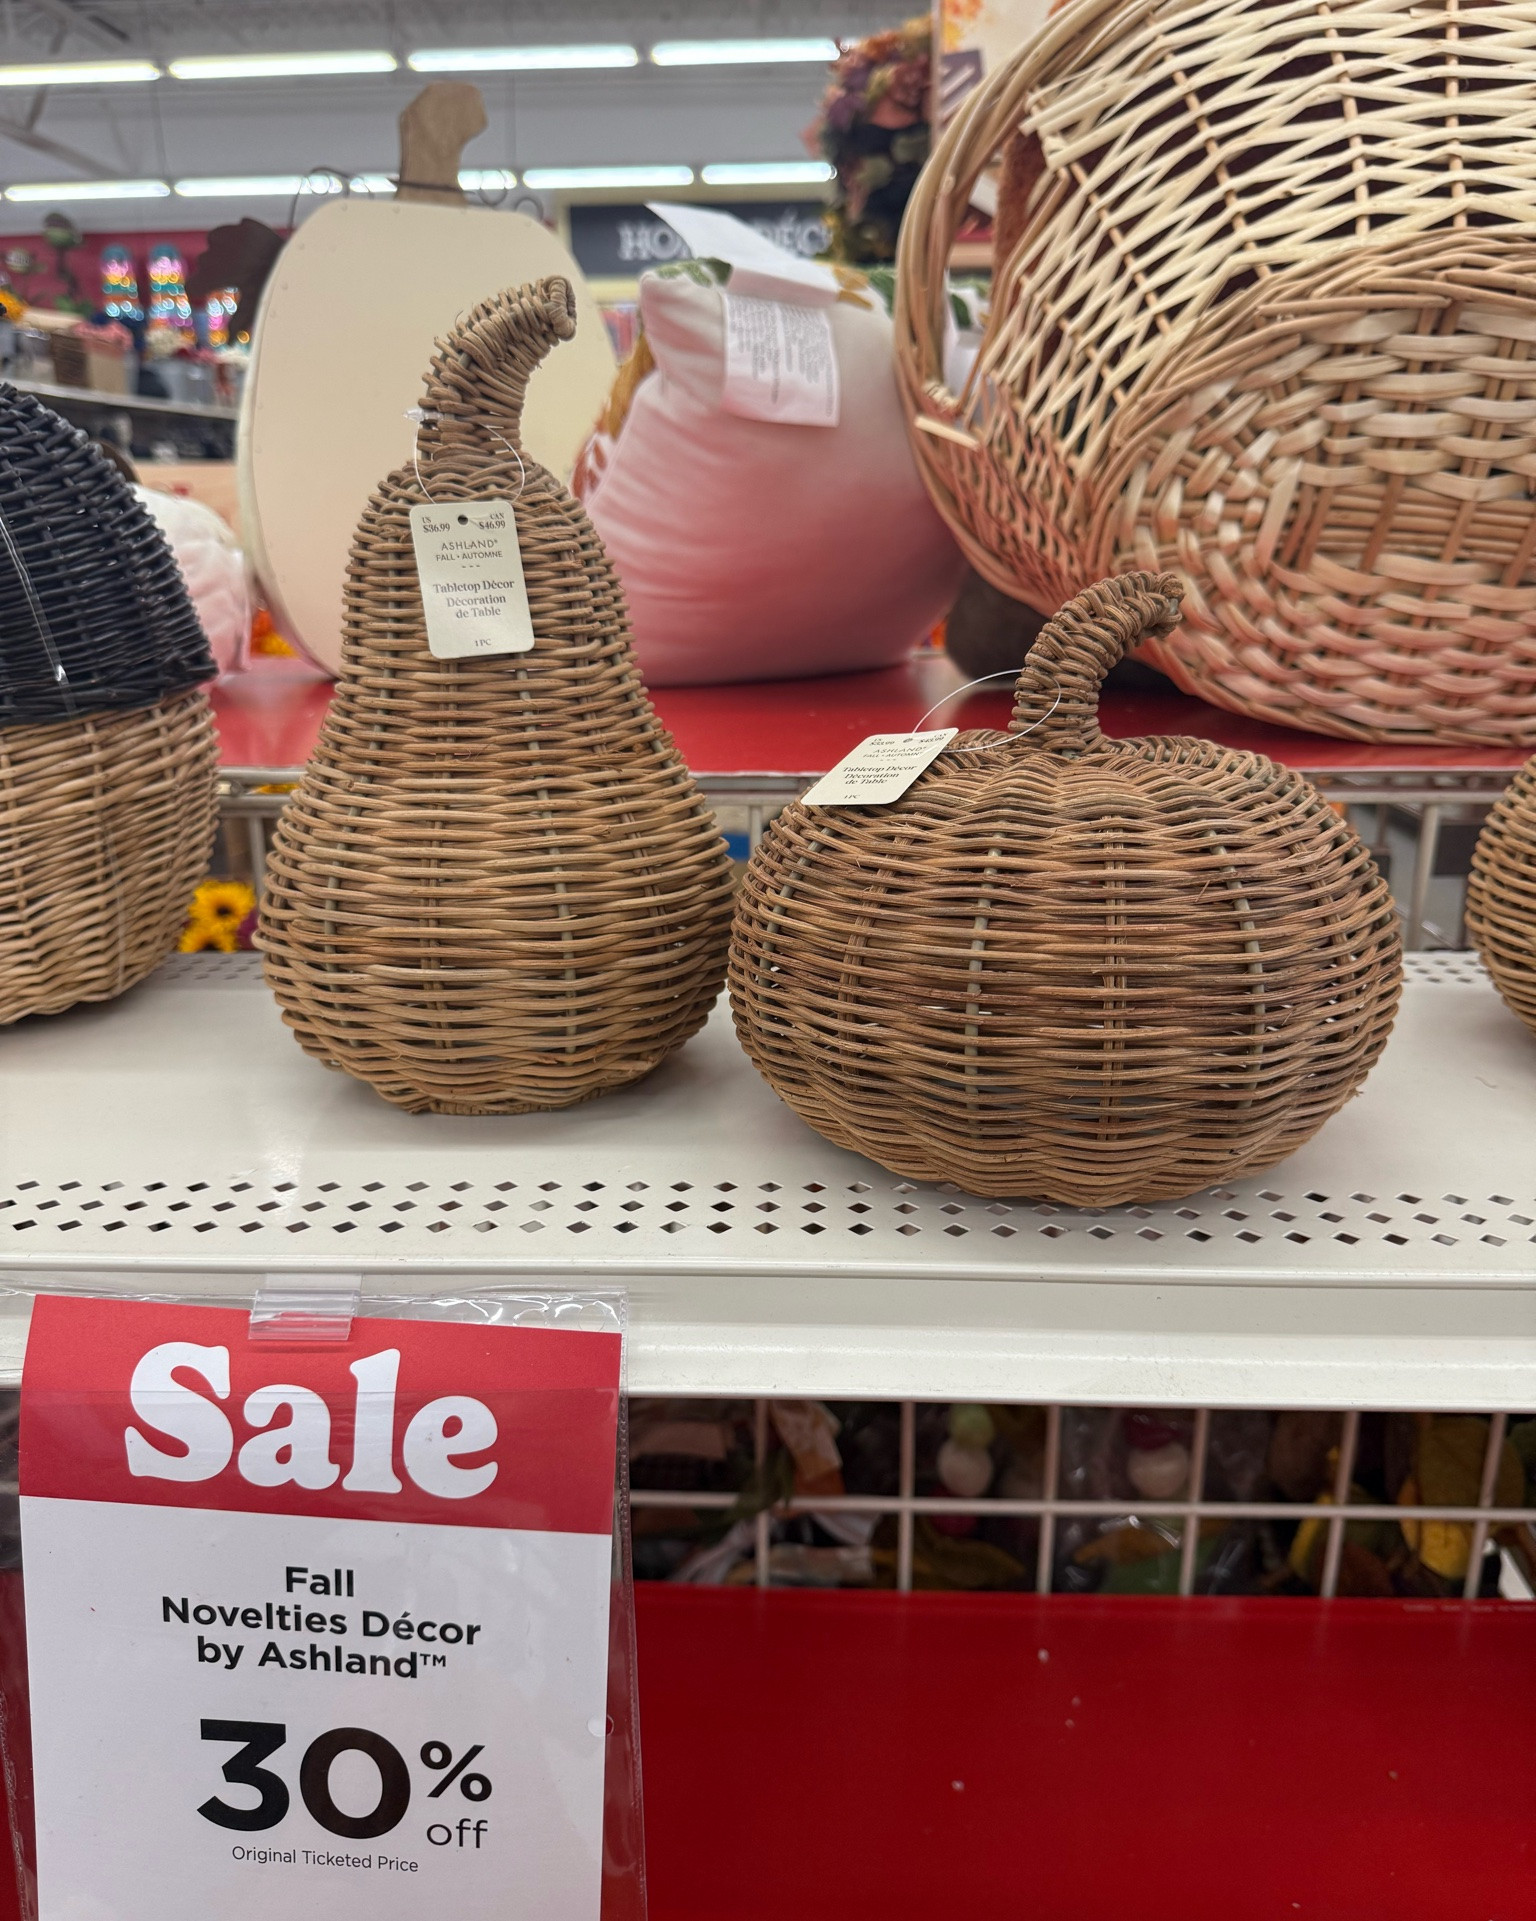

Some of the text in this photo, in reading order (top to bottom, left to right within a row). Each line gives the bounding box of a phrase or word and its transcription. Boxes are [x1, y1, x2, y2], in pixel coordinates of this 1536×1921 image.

[423, 523, 450, 533] $36.99
[479, 520, 506, 530] $46.99
[462, 551, 503, 560] AUTOMNE
[433, 580, 515, 594] Tabletop Décor
[446, 594, 506, 608] Décoration
[456, 607, 501, 619] de Table
[124, 1341, 499, 1500] Sale
[285, 1565, 355, 1598] Fall
[162, 1596, 481, 1645] Novelties Décor
[198, 1636, 244, 1670] by
[426, 1818, 489, 1849] off
[233, 1846, 418, 1872] Original Ticketed Price
